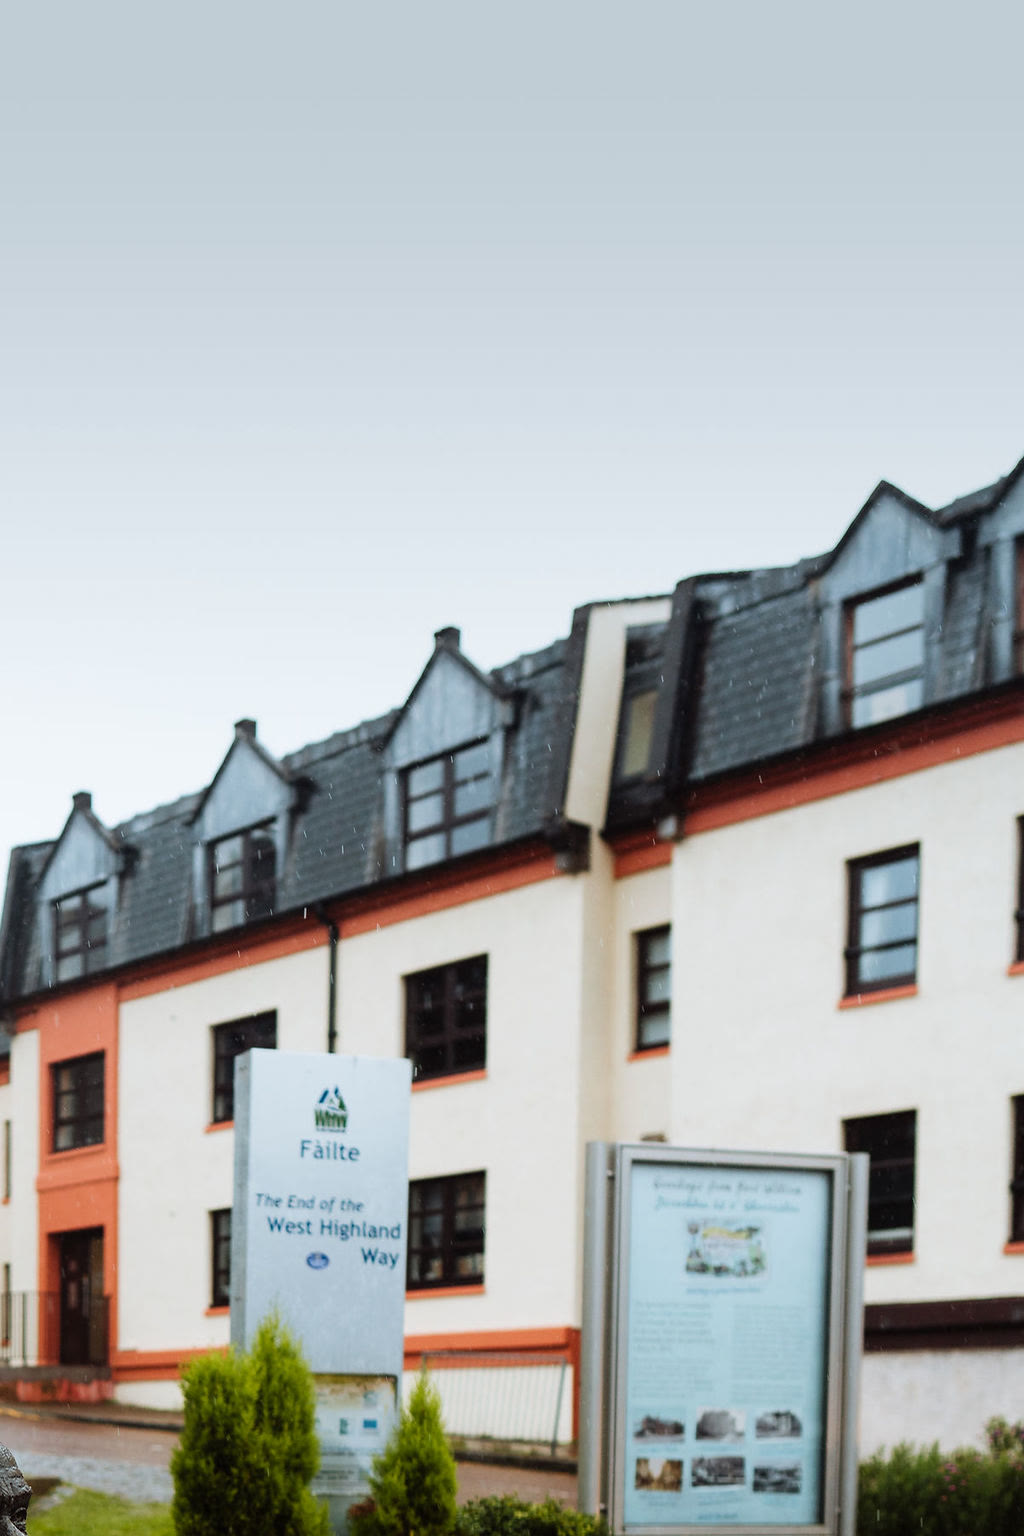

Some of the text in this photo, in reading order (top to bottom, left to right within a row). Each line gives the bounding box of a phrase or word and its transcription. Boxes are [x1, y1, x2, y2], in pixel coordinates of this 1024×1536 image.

[300, 1139, 360, 1161] Fàilte
[255, 1193, 365, 1213] The End of the
[267, 1216, 401, 1242] West Highland
[361, 1247, 400, 1270] Way
